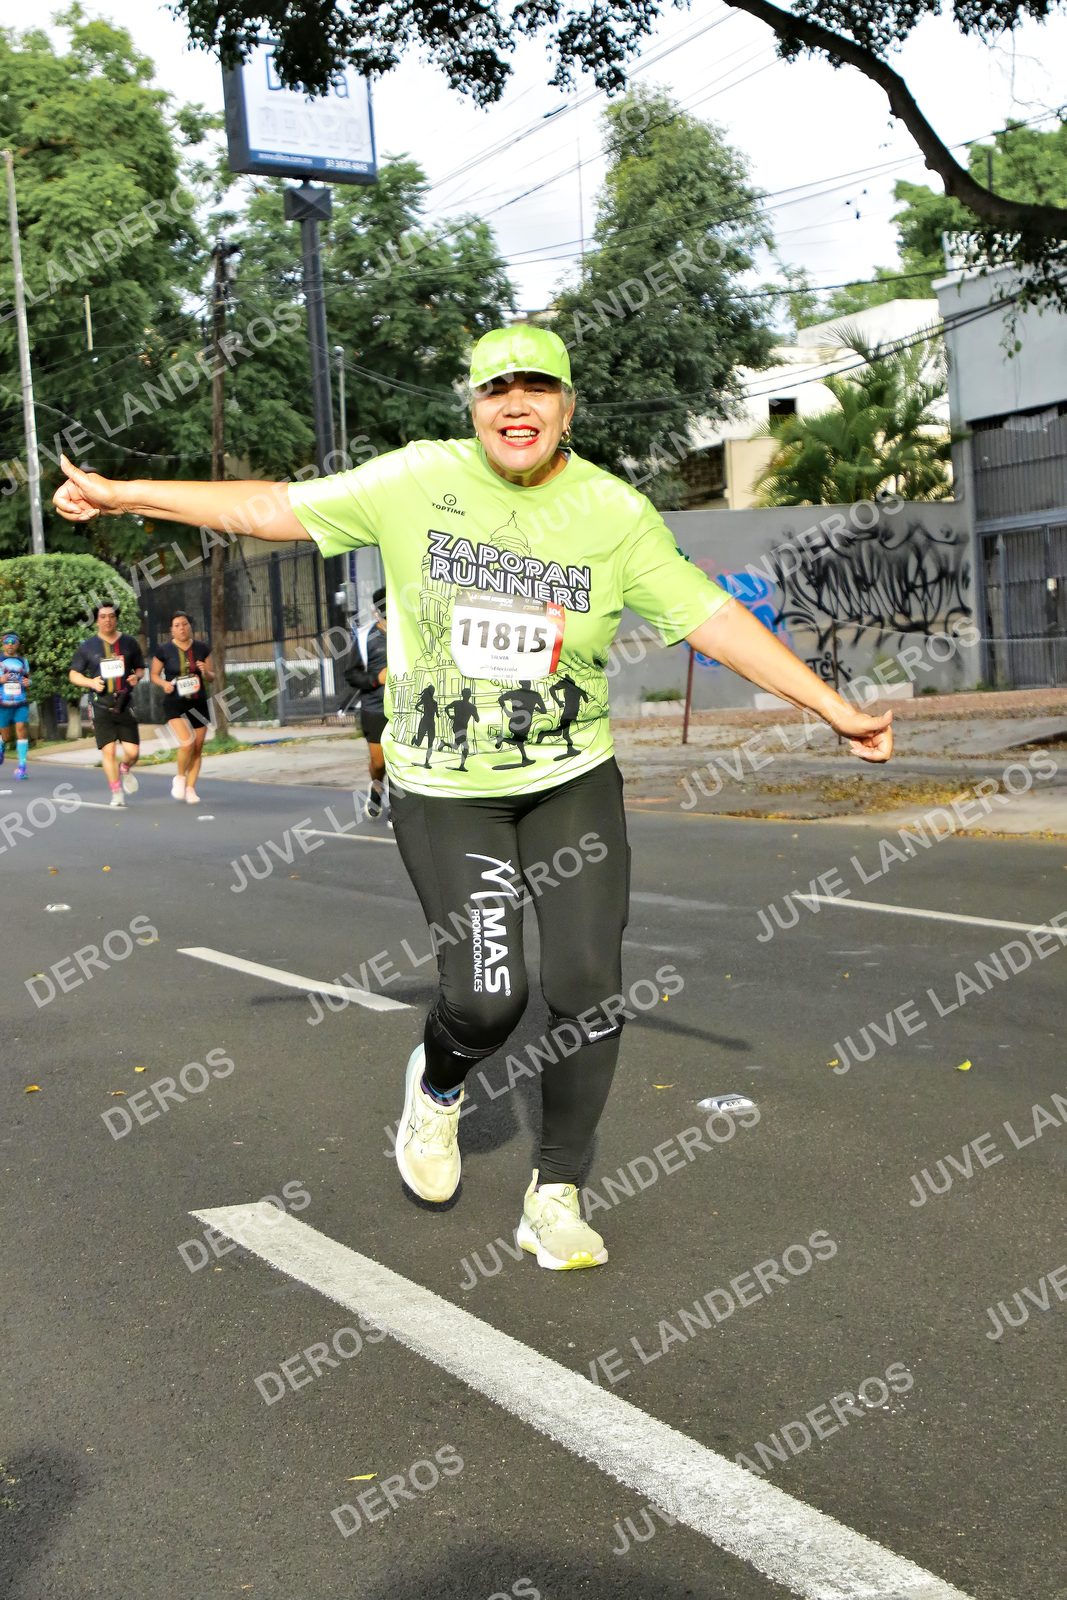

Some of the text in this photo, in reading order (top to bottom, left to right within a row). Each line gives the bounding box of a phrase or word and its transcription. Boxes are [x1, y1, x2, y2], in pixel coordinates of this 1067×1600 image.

[432, 502, 466, 516] TOPTIME
[428, 530, 591, 590] ZAPOPAN
[430, 556, 591, 613] RUNNERS
[459, 618, 548, 653] 11815
[470, 908, 483, 993] PROMOCIONALES
